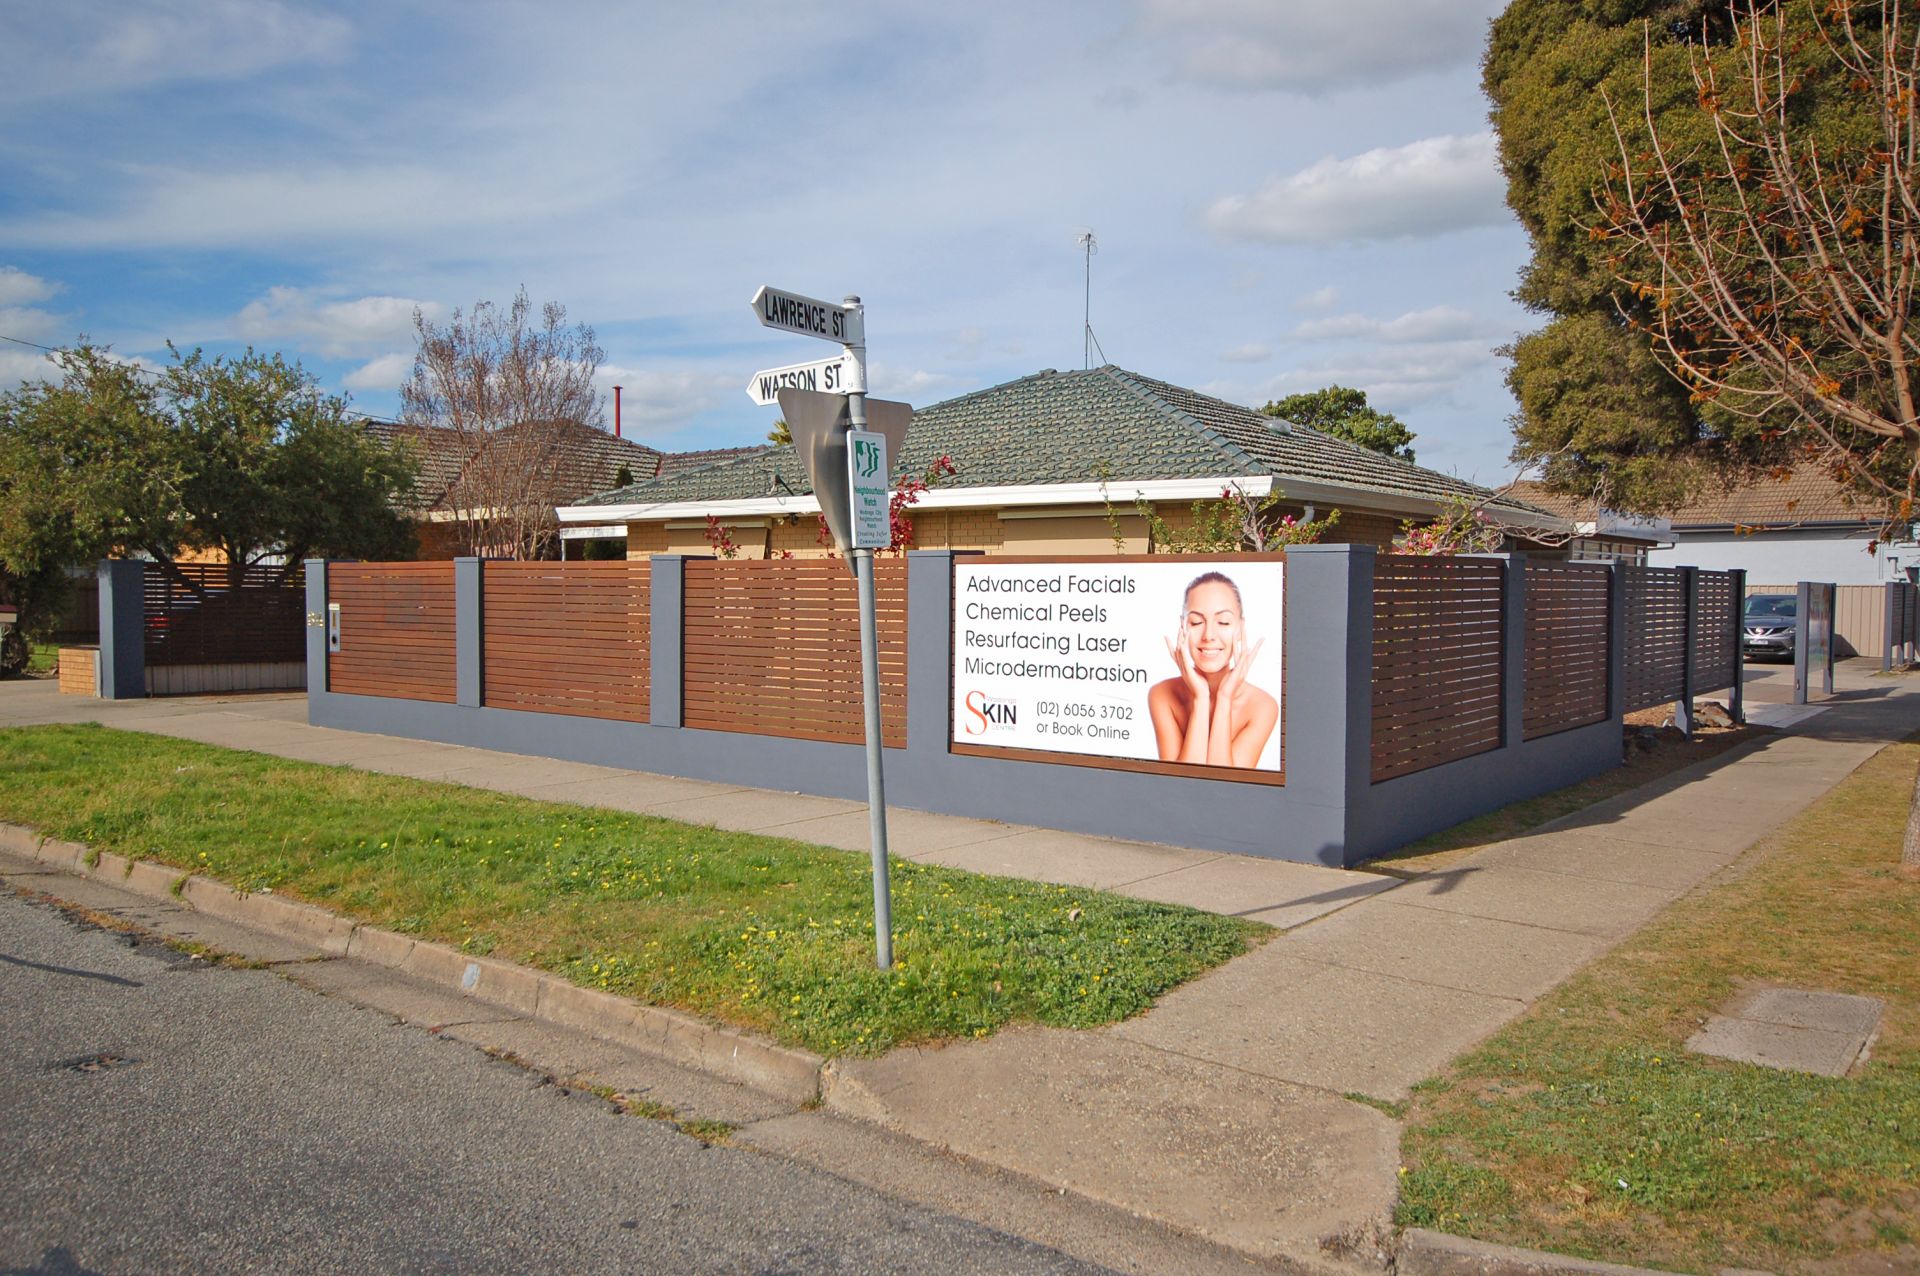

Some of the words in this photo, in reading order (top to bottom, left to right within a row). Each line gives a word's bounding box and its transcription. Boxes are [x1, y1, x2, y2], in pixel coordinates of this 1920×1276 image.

[764, 293, 826, 334] LAWRENCE
[832, 311, 845, 338] ST
[759, 368, 817, 400] WATSON
[824, 363, 842, 389] ST
[967, 575, 1061, 593] Advanced
[1068, 575, 1136, 594] Facials
[966, 602, 1052, 621] Chemical
[1059, 604, 1107, 623] Peels
[965, 630, 1070, 654] Resurfacing
[1077, 633, 1127, 653] Laser
[965, 657, 1148, 683] Microdermabrasion
[965, 690, 1017, 736] SKIN
[1036, 700, 1060, 717] (02)
[1064, 703, 1096, 718] 6056
[1100, 705, 1133, 720] 3702
[1036, 723, 1050, 733] or
[1052, 721, 1083, 737] Book
[1087, 724, 1130, 740] Online
